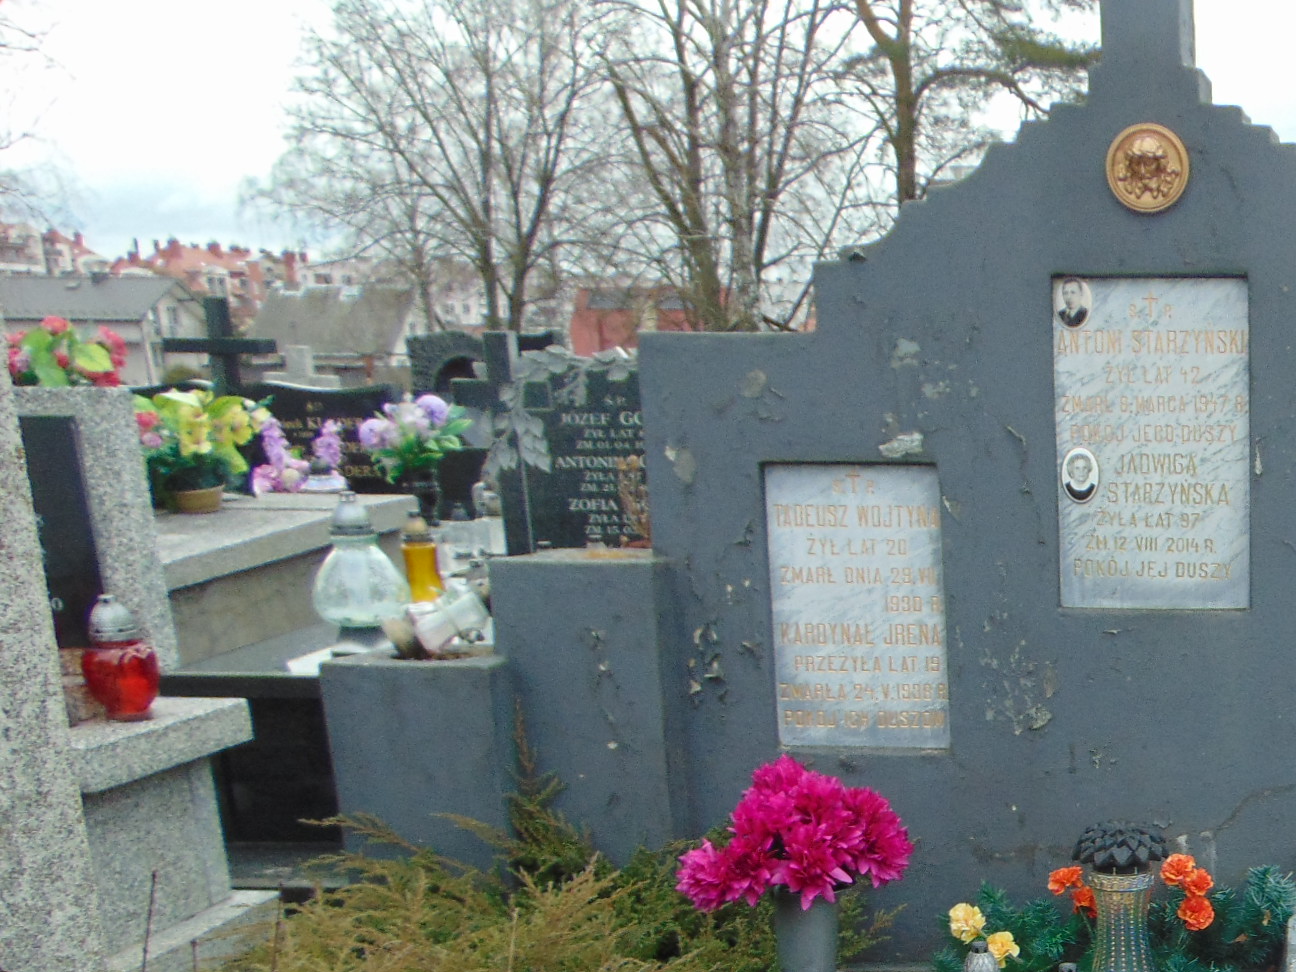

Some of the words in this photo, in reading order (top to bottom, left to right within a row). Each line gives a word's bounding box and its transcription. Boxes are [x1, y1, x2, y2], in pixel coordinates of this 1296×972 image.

[1058, 330, 1123, 354] ANTONI
[1180, 366, 1200, 384] 42
[1182, 424, 1238, 443] DUSZY
[1115, 453, 1197, 475] JADWIGA
[1107, 479, 1230, 505] STARZYŃSKA
[569, 499, 619, 511] ZOFIA
[774, 504, 849, 528] TADEUSZ
[857, 505, 941, 528] WOJTYNA
[848, 538, 878, 555] LAT
[886, 539, 908, 556] 20
[1135, 536, 1158, 551] VIII
[1167, 538, 1199, 553] 2014
[780, 566, 837, 584] ZMARŁ
[845, 567, 882, 584] DNIA
[1073, 556, 1129, 577] POKÓJ
[1136, 561, 1168, 578] JEJ
[1176, 562, 1232, 579] DUSZY
[884, 595, 923, 613] 1930
[780, 623, 876, 646] KARDYNAŁ
[888, 656, 918, 672] LAT
[779, 682, 846, 701] ZMARŁA
[845, 710, 869, 728] ICH
